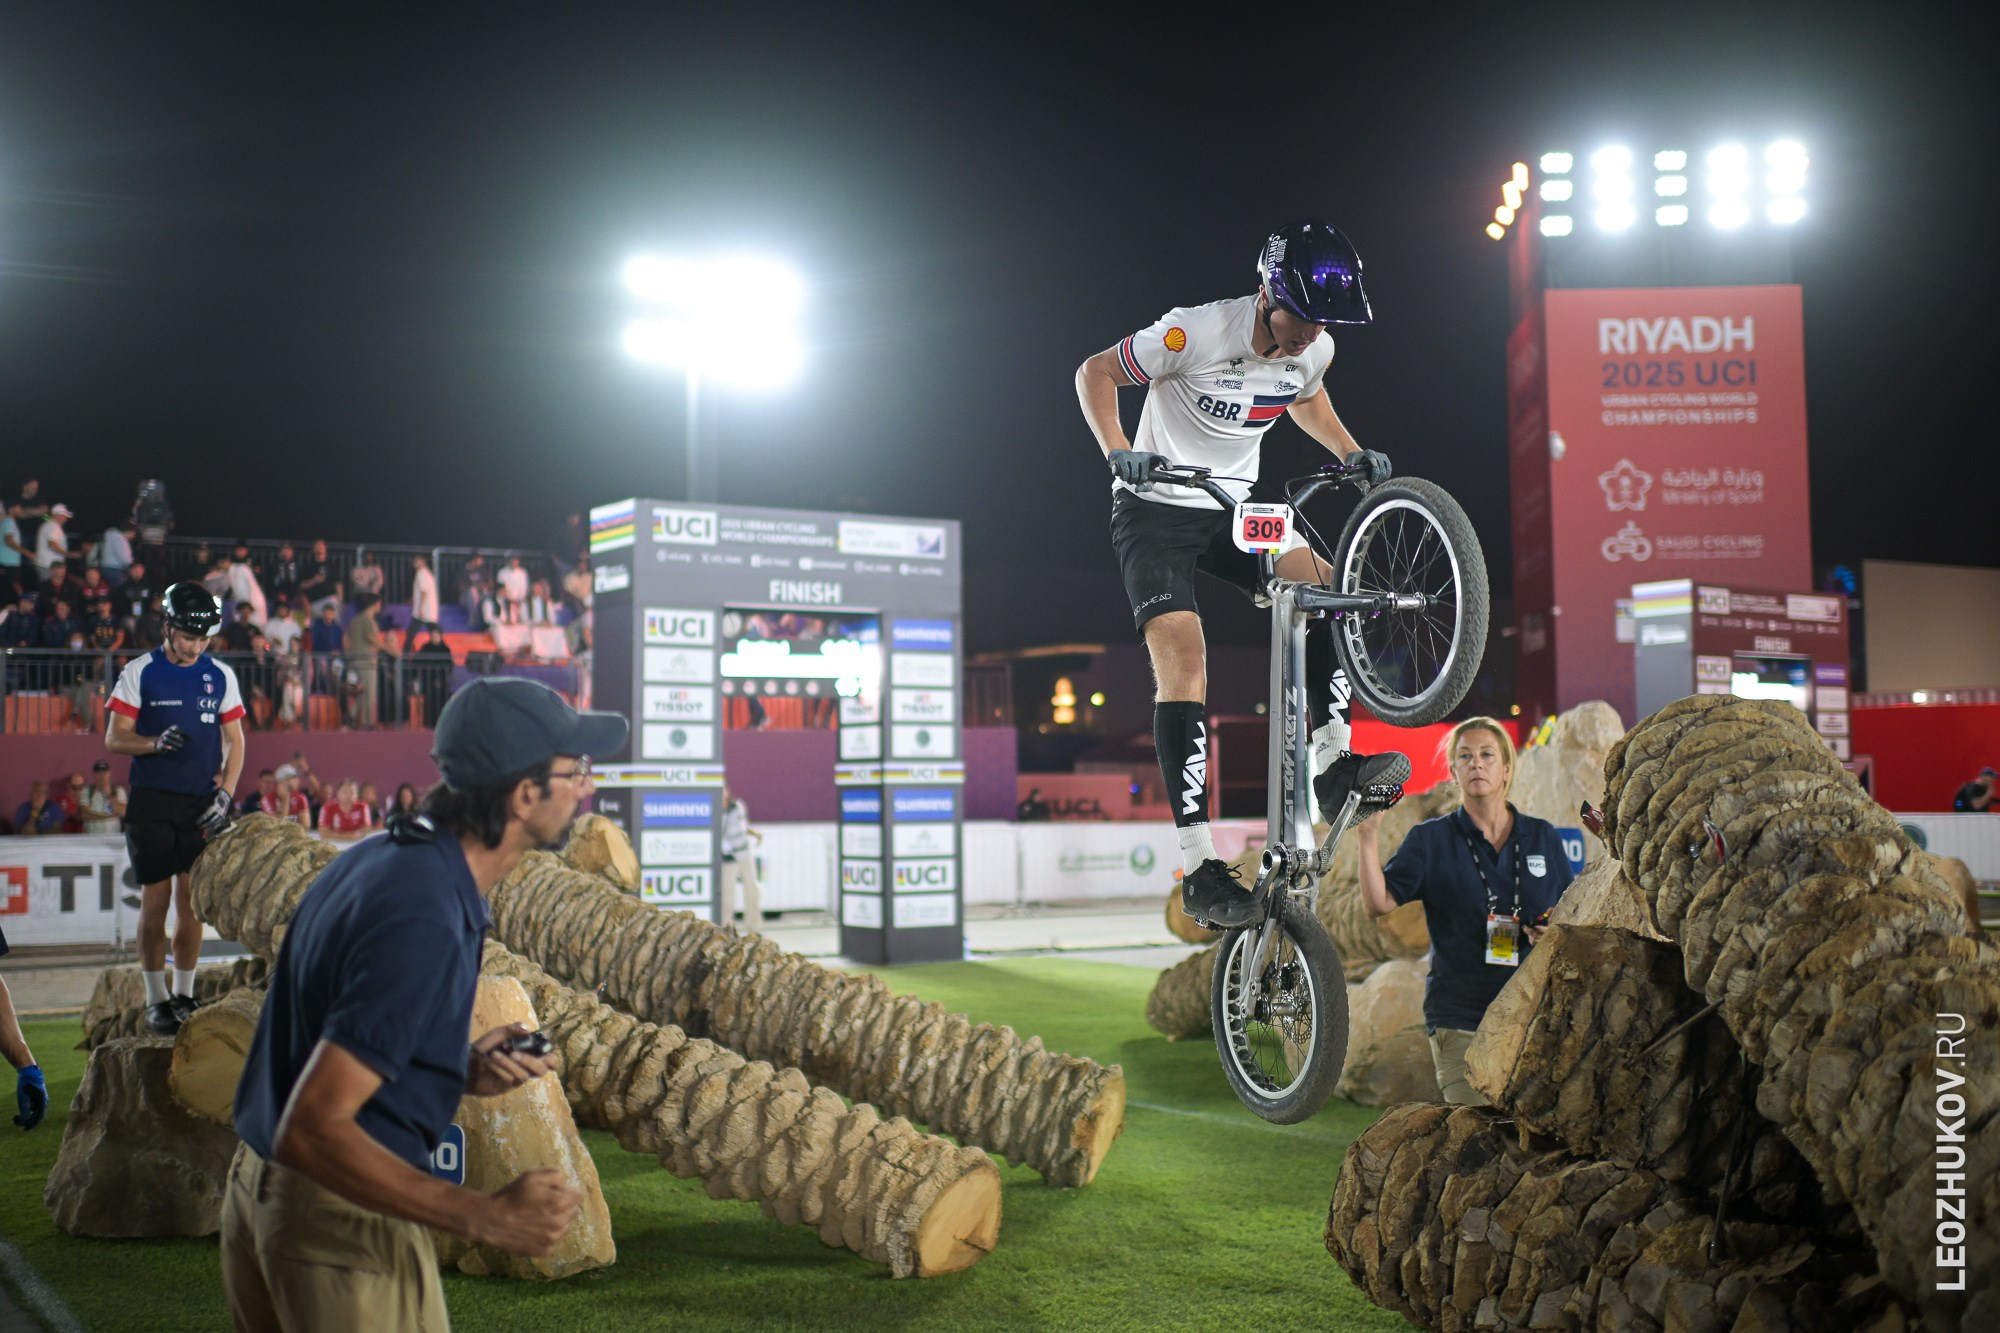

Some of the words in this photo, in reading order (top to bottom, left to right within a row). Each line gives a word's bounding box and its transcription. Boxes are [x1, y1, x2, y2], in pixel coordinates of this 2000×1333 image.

[1267, 235, 1280, 272] CONTROL
[1599, 316, 1754, 354] RIYADH
[1221, 369, 1246, 377] LLOYDS
[1602, 361, 1685, 388] 2025
[1695, 359, 1757, 387] UCI
[1197, 395, 1242, 421] GBR
[1602, 394, 1648, 407] URBAN
[1651, 393, 1707, 406] CYCLING
[1710, 391, 1758, 405] WORLD
[1602, 408, 1758, 426] CHAMPIONSHIPS
[665, 515, 711, 538] UCI
[1247, 519, 1283, 540] 309
[1656, 535, 1699, 550] SAUDI
[1704, 534, 1763, 550] CYCLING
[769, 580, 842, 603] FINISH
[1141, 593, 1172, 609] AHEAD
[660, 617, 705, 638] UCI
[654, 702, 703, 713] TISSOT
[902, 704, 943, 715] TISSOT
[663, 770, 691, 782] UCI
[909, 769, 934, 779] UCI
[850, 867, 876, 885] UCI
[907, 867, 947, 885] UCI
[656, 875, 703, 896] UCI
